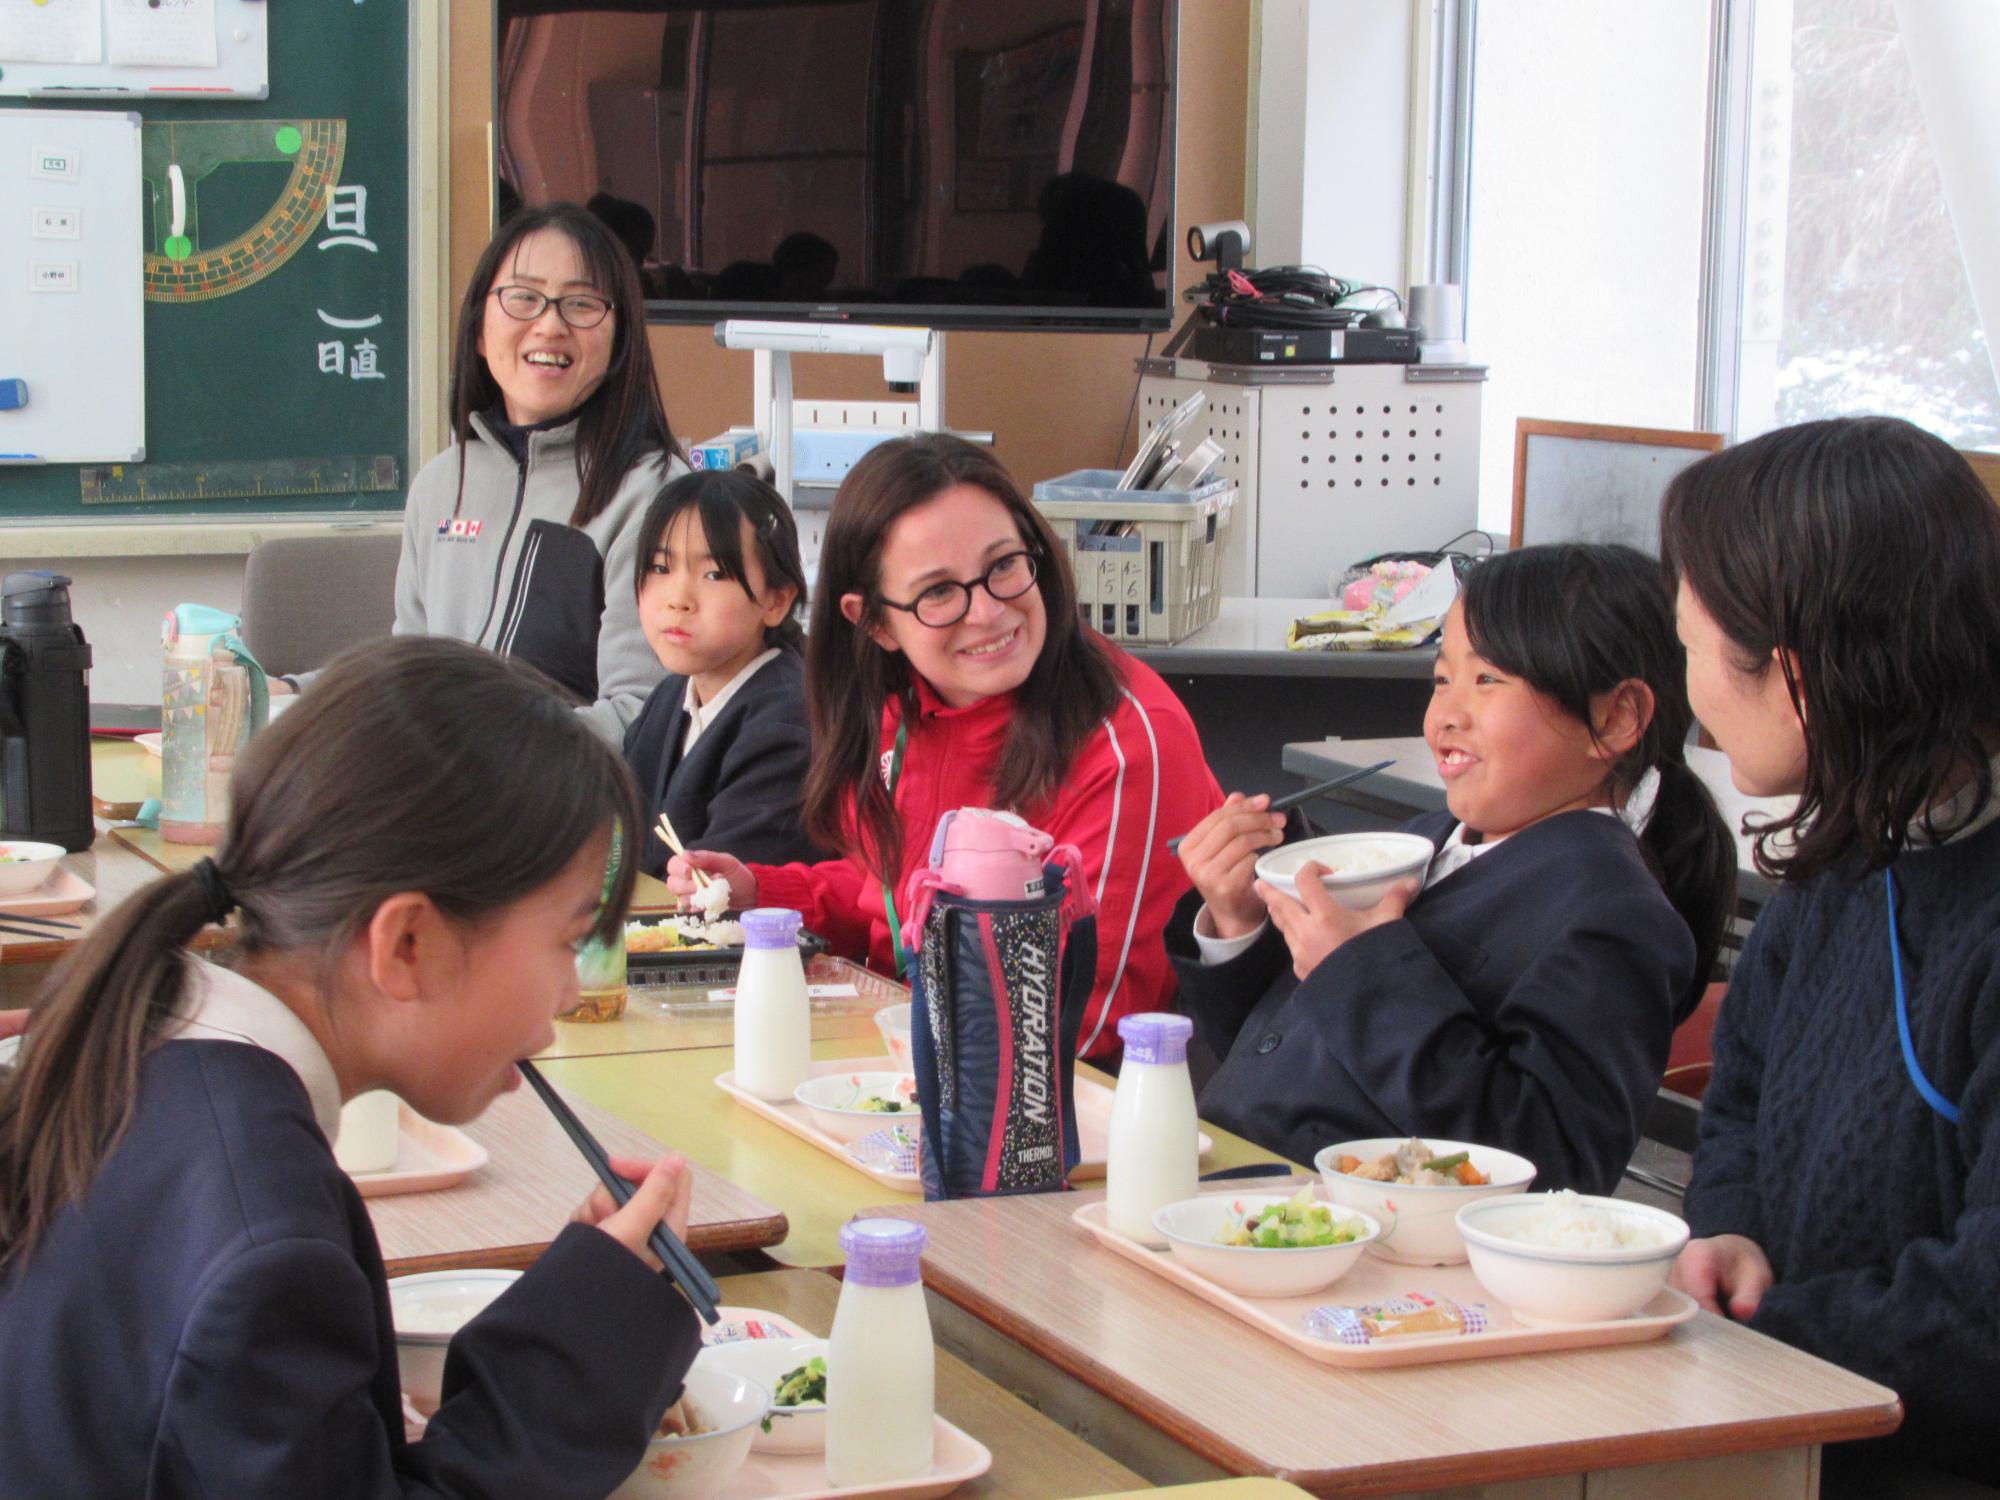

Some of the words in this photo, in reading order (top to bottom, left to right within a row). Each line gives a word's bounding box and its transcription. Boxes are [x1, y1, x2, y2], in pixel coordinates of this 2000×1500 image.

[317, 337, 386, 380] 日直
[1021, 941, 1048, 1124] HYDRATION
[1017, 1145, 1053, 1164] THERMOS
